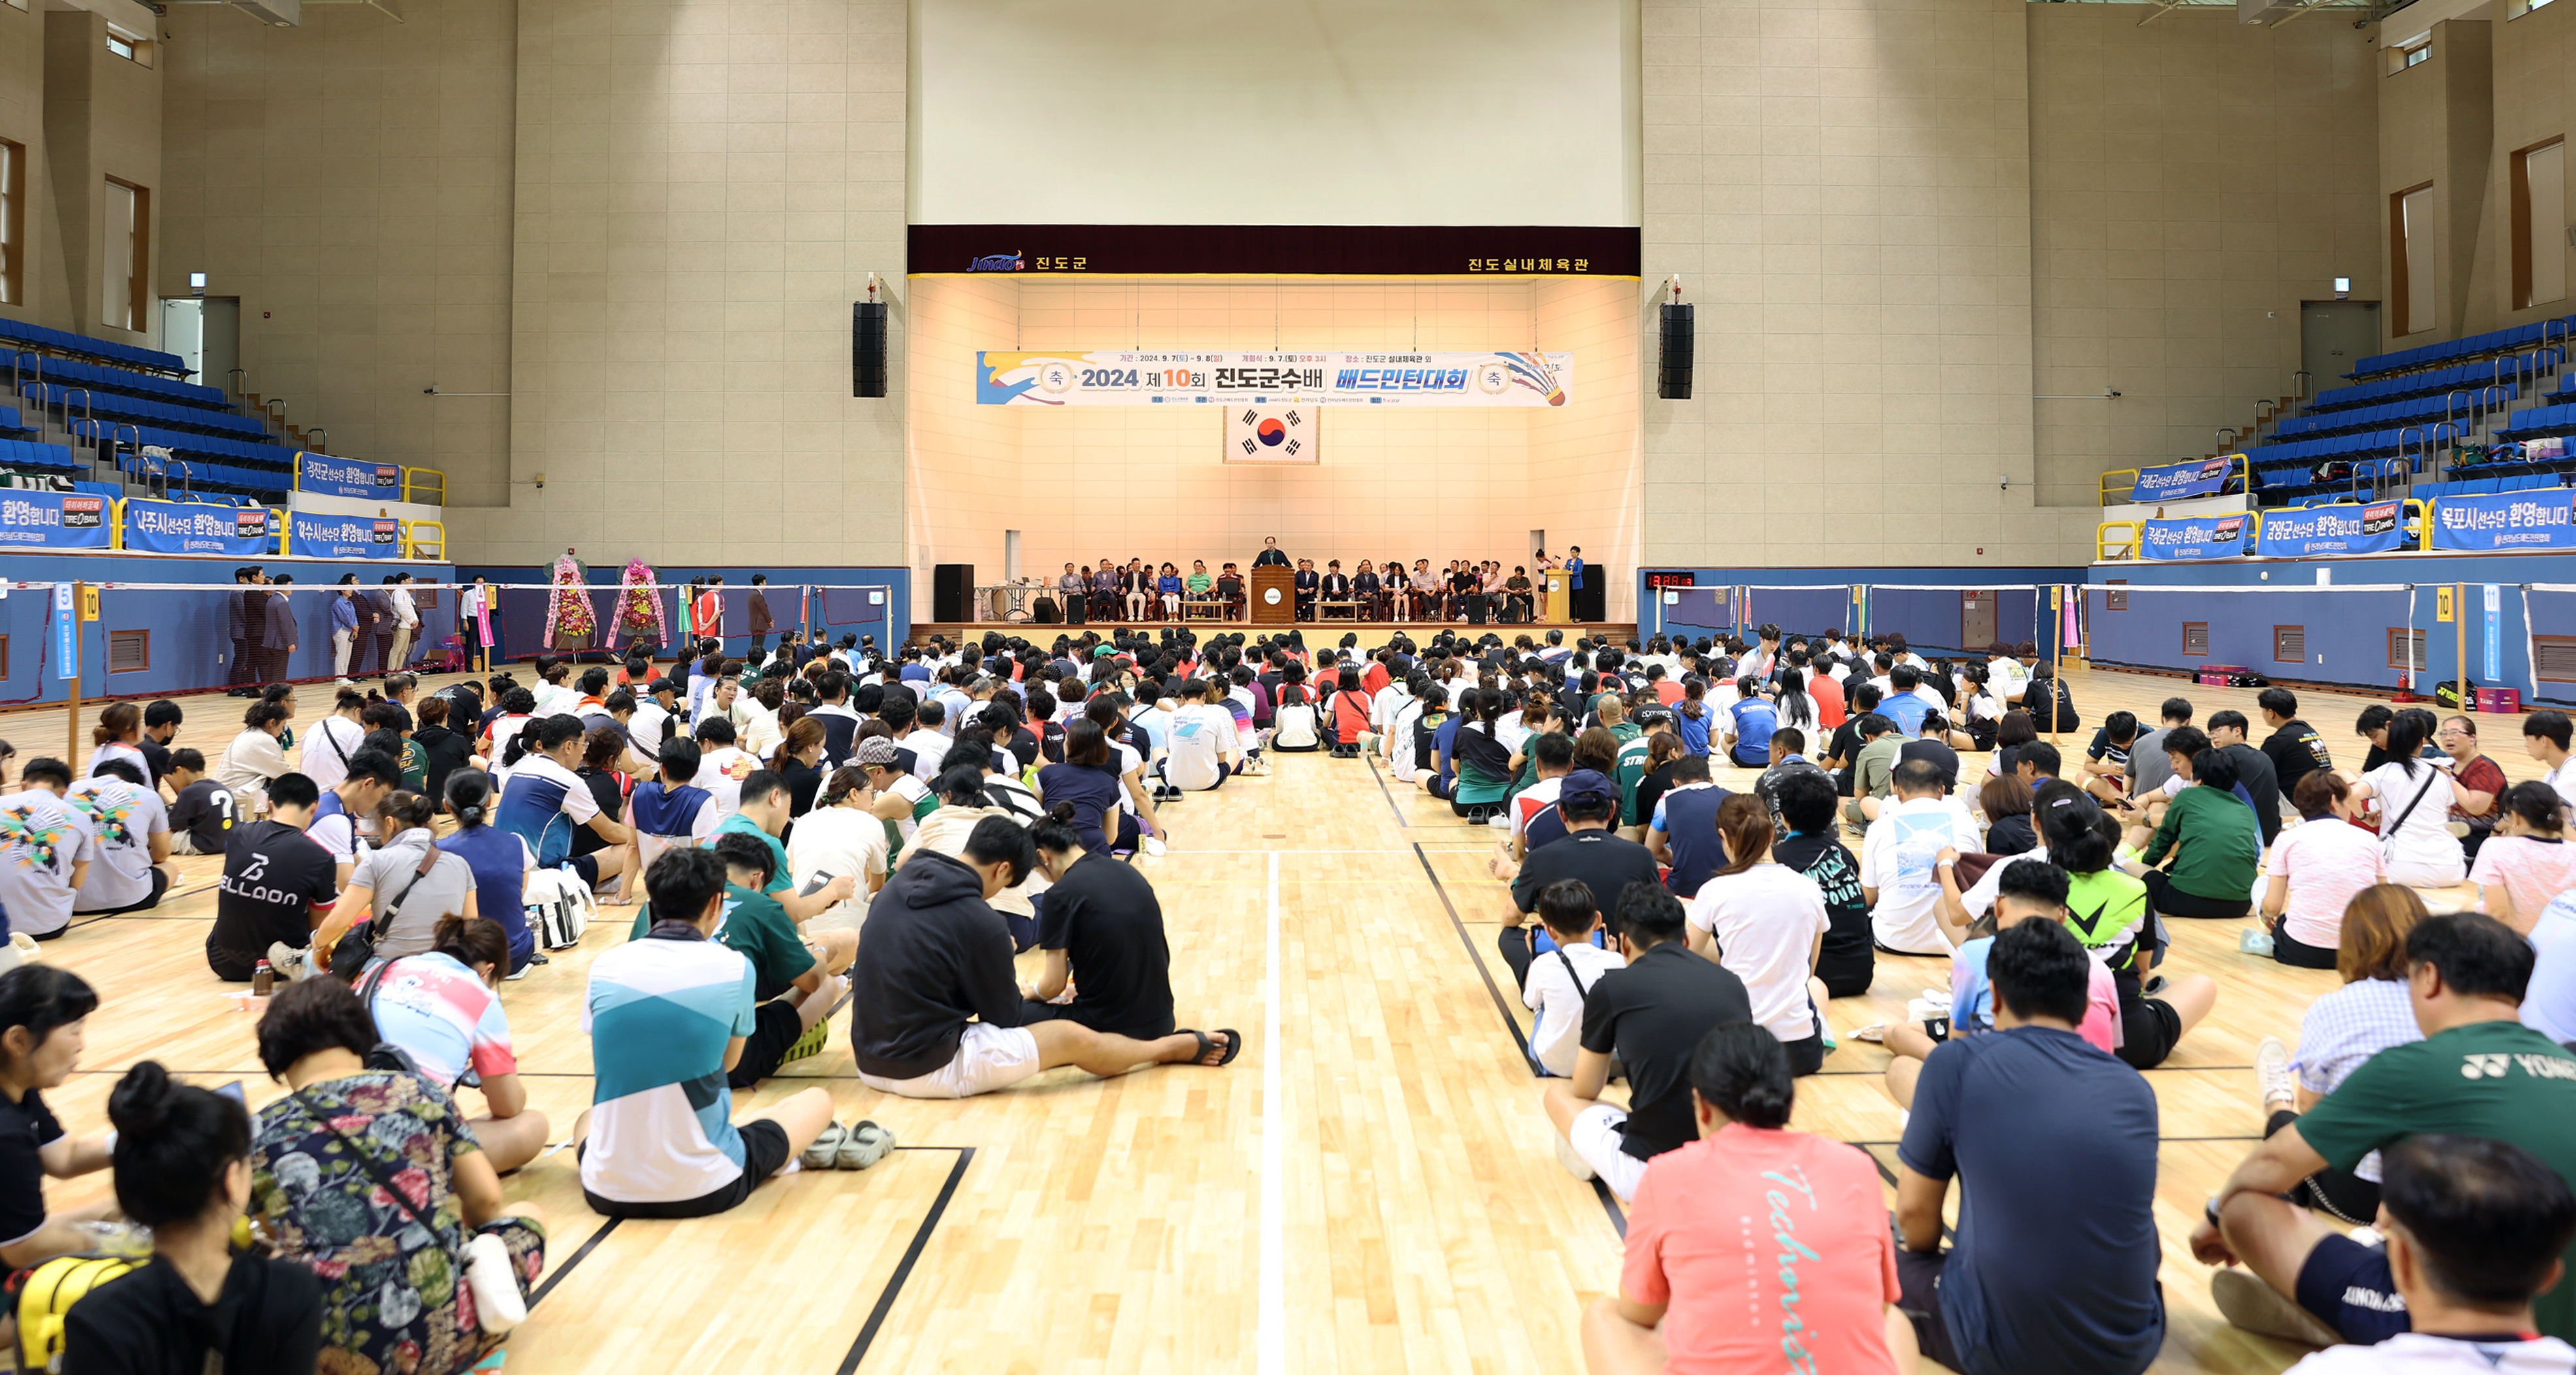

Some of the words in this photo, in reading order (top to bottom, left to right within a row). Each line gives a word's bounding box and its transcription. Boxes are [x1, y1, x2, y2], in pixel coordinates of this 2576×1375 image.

[1036, 257, 1087, 270] 진도군
[1468, 258, 1589, 271] 진도실내체육관
[1049, 371, 1064, 386] 축
[1082, 369, 1139, 387] 2024
[1146, 369, 1206, 388] 제10회
[1215, 368, 1323, 389] 진도군수배
[1336, 369, 1468, 389] 배드민턴대회
[1487, 371, 1501, 386] 축
[346, 466, 375, 486] 환영합니다
[2171, 470, 2201, 486] 환영합니다
[2, 499, 59, 526] 환영합니다
[2441, 506, 2507, 531] 목포시선수단
[2509, 501, 2569, 527] 환영합니다
[194, 513, 235, 537] 환영합니다
[340, 523, 372, 543] 환영합니다
[2183, 525, 2214, 544] 환영합니다
[2315, 516, 2360, 537] 환영합니다
[61, 588, 70, 605] 5
[86, 593, 97, 614] 10
[2439, 595, 2449, 614] 10
[2486, 589, 2496, 607] 11
[2513, 1052, 2576, 1082] YONE
